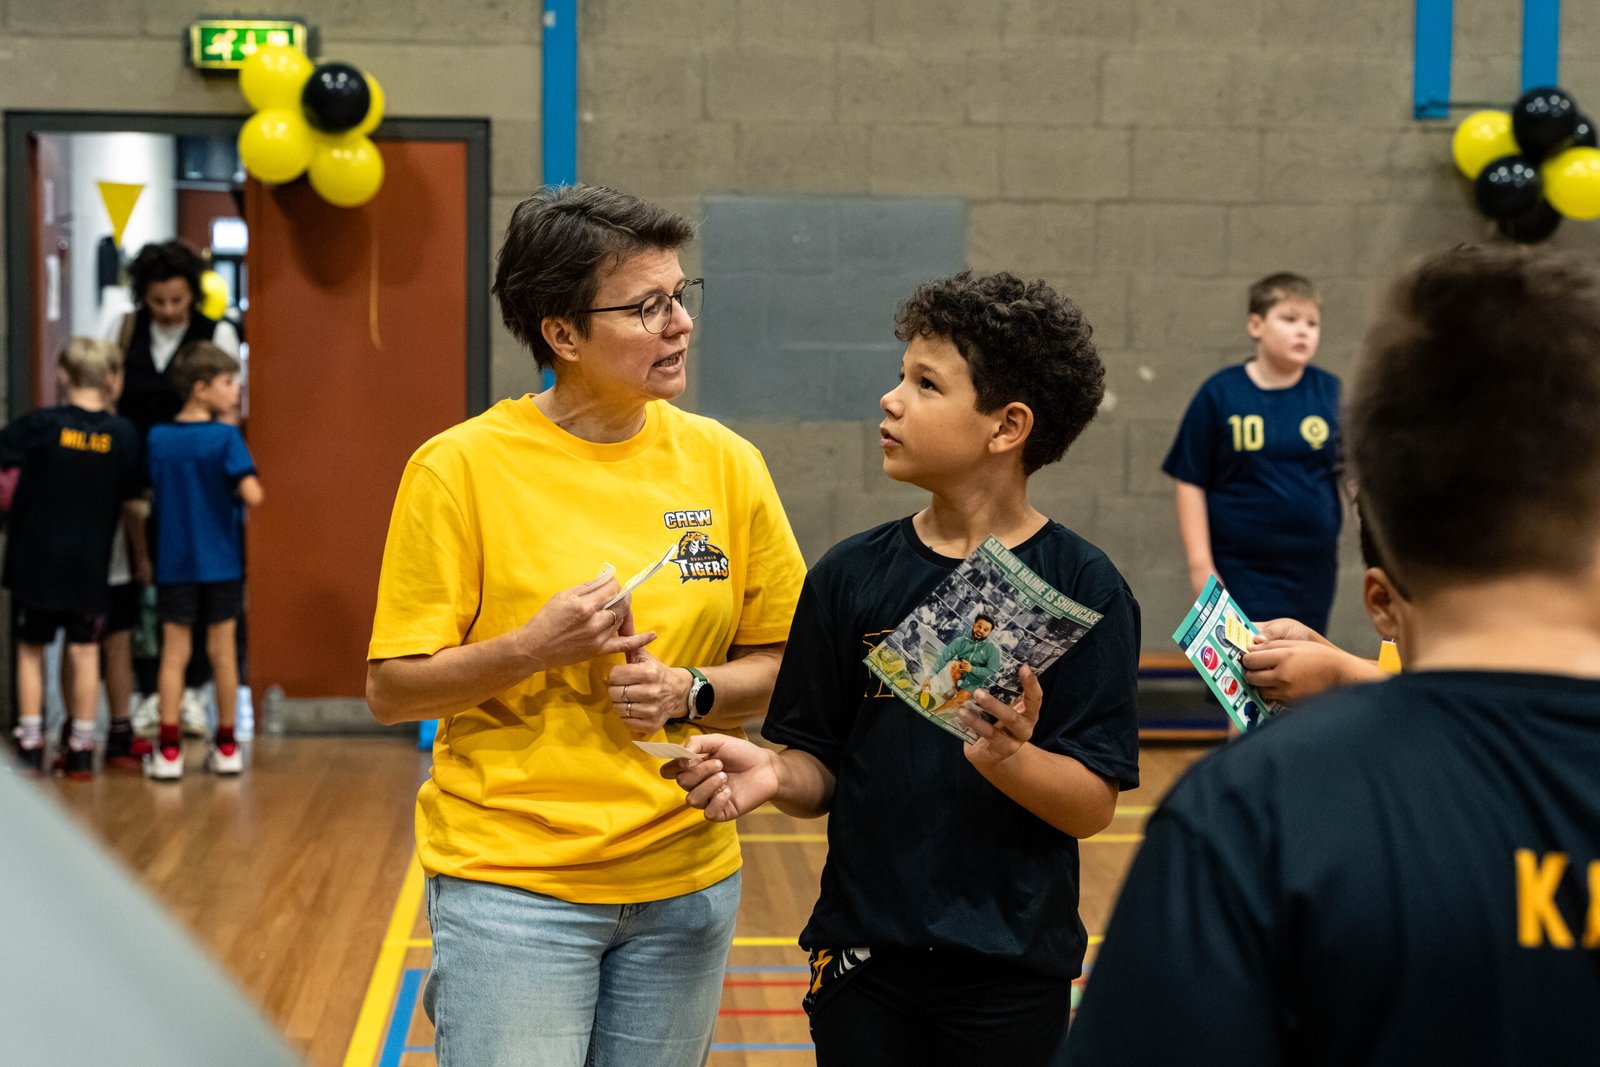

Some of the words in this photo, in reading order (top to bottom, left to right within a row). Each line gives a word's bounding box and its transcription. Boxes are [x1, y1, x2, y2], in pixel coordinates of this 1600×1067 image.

[1227, 414, 1265, 452] 10
[664, 509, 712, 529] CREW
[672, 557, 729, 579] TIGERS
[1053, 595, 1102, 626] SHOWCASE
